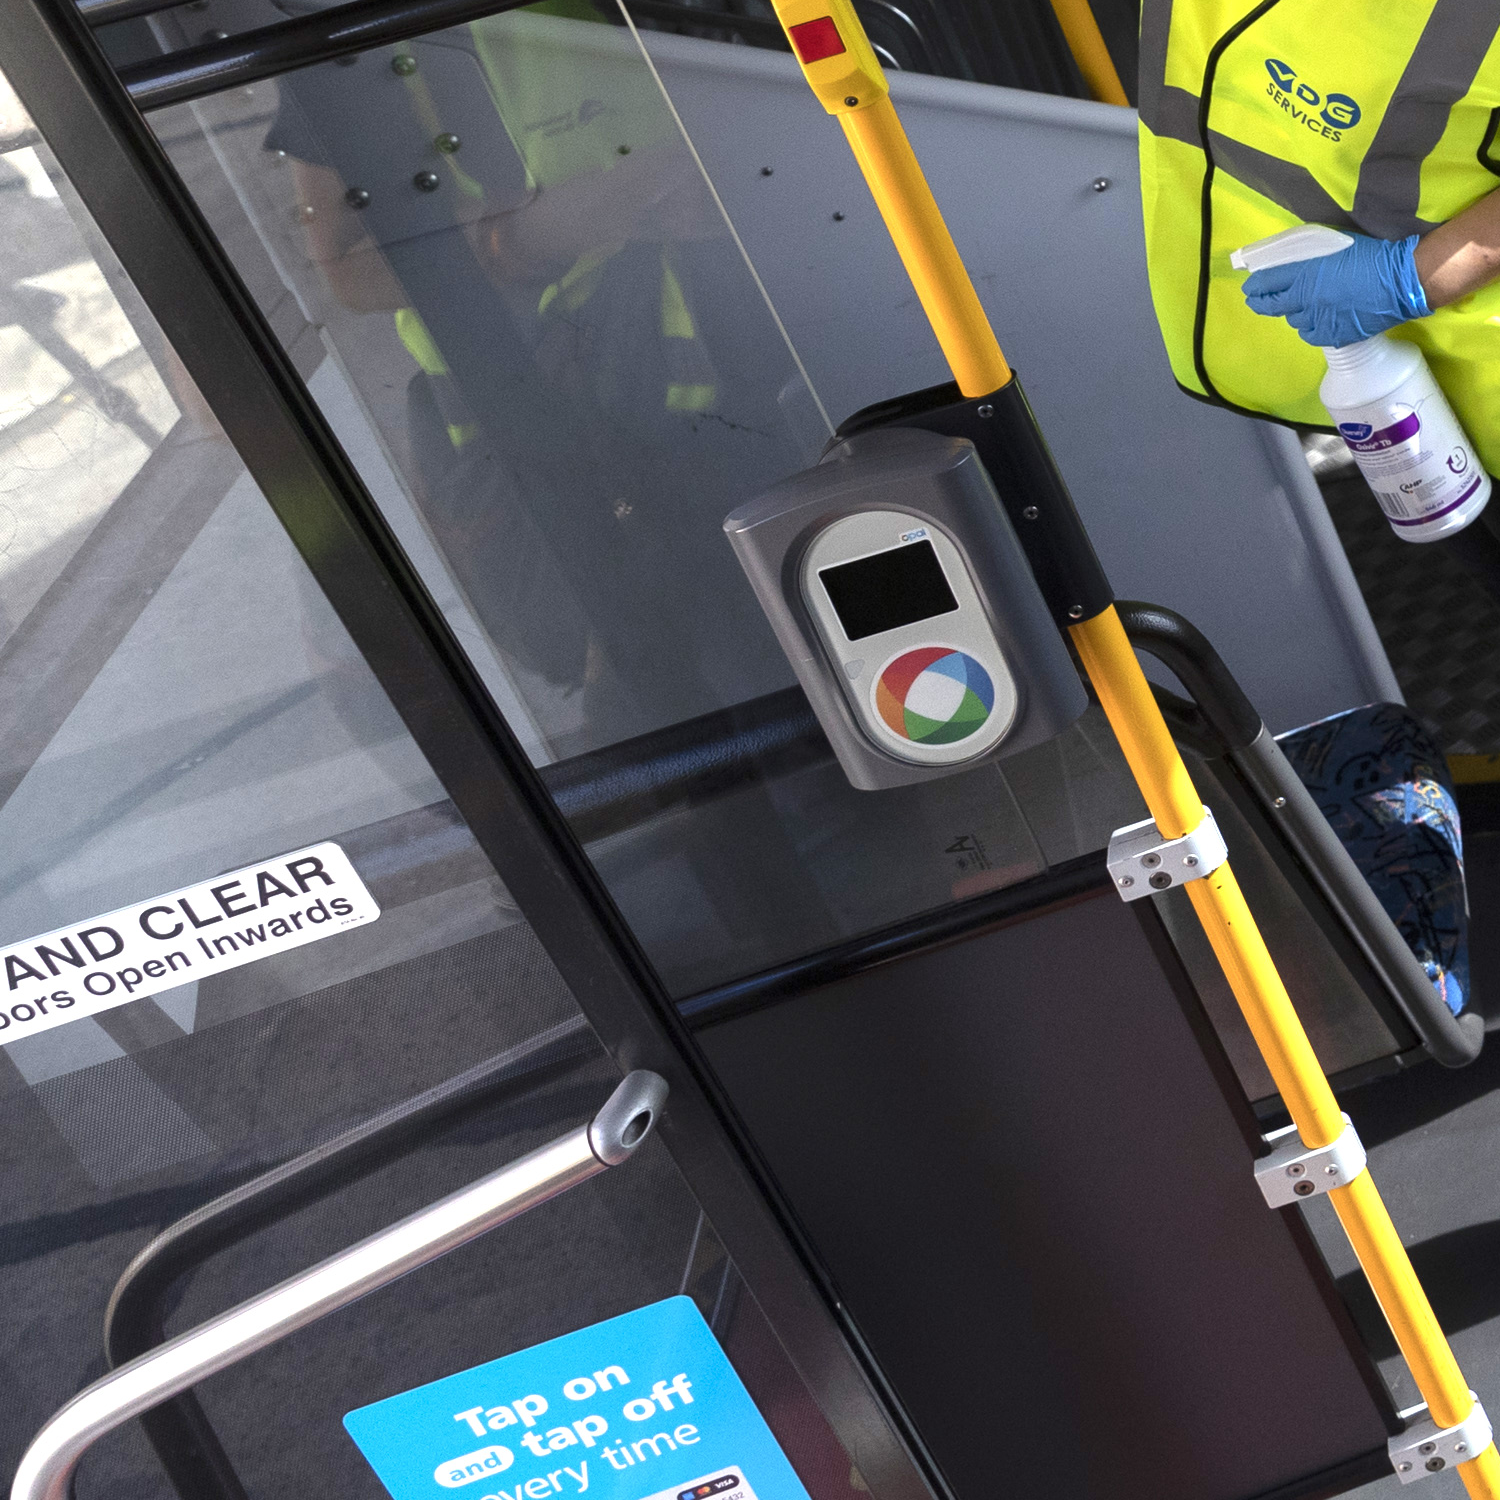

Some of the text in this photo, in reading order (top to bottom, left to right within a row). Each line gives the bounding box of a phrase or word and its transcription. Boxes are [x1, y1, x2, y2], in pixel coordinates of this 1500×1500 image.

[1265, 58, 1361, 129] VDG
[1266, 83, 1342, 142] SERVICES
[4, 855, 336, 991] AND CLEAR
[83, 951, 192, 994] Open
[196, 896, 354, 961] Inwards
[449, 1373, 696, 1482] and tap off
[454, 1364, 631, 1438] Tap on
[600, 1422, 701, 1471] time
[714, 1478, 735, 1489] VISA
